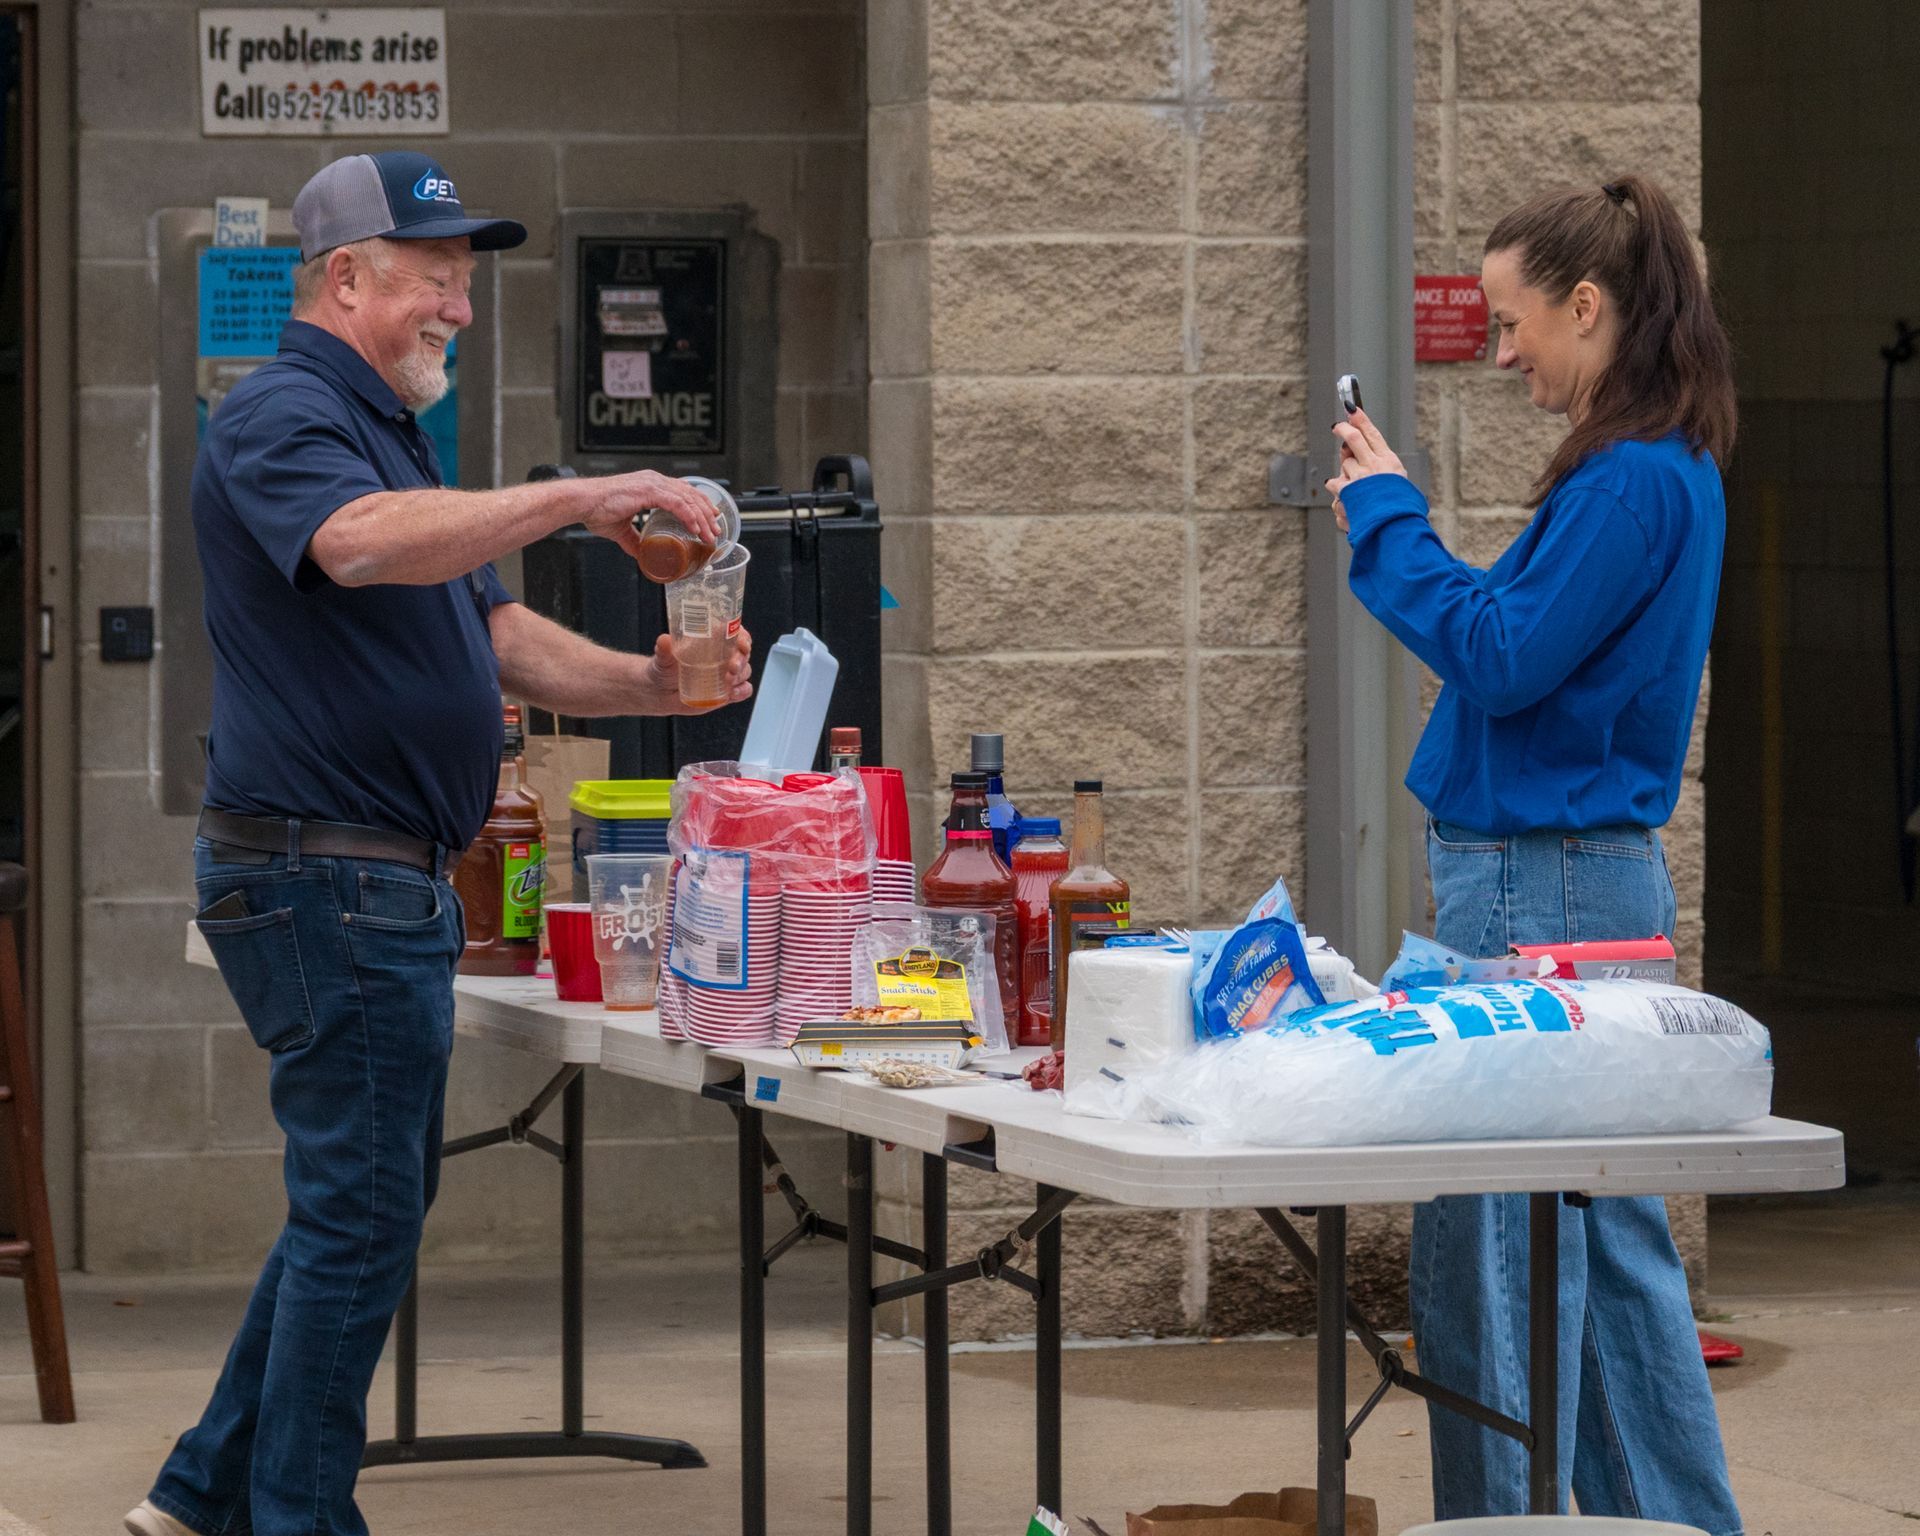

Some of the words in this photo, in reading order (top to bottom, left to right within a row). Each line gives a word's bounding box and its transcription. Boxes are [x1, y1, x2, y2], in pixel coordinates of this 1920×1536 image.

[208, 26, 231, 61] If
[239, 25, 362, 74] problems
[372, 32, 439, 63] arise
[215, 82, 265, 119] Call
[423, 178, 457, 196] PET
[218, 203, 258, 225] Best
[217, 226, 262, 247] Deal
[228, 267, 285, 282] Tokens
[1449, 288, 1482, 306] DOOR
[588, 391, 712, 426] CHANGE
[1216, 964, 1249, 1007] CRYSTAL
[1249, 940, 1278, 971] FARMS
[1634, 968, 1669, 977] PLASTIC
[880, 986, 908, 995] Snack
[910, 986, 937, 996] Sticks
[1227, 984, 1258, 1027] SNACK
[1253, 954, 1290, 993] CUBES
